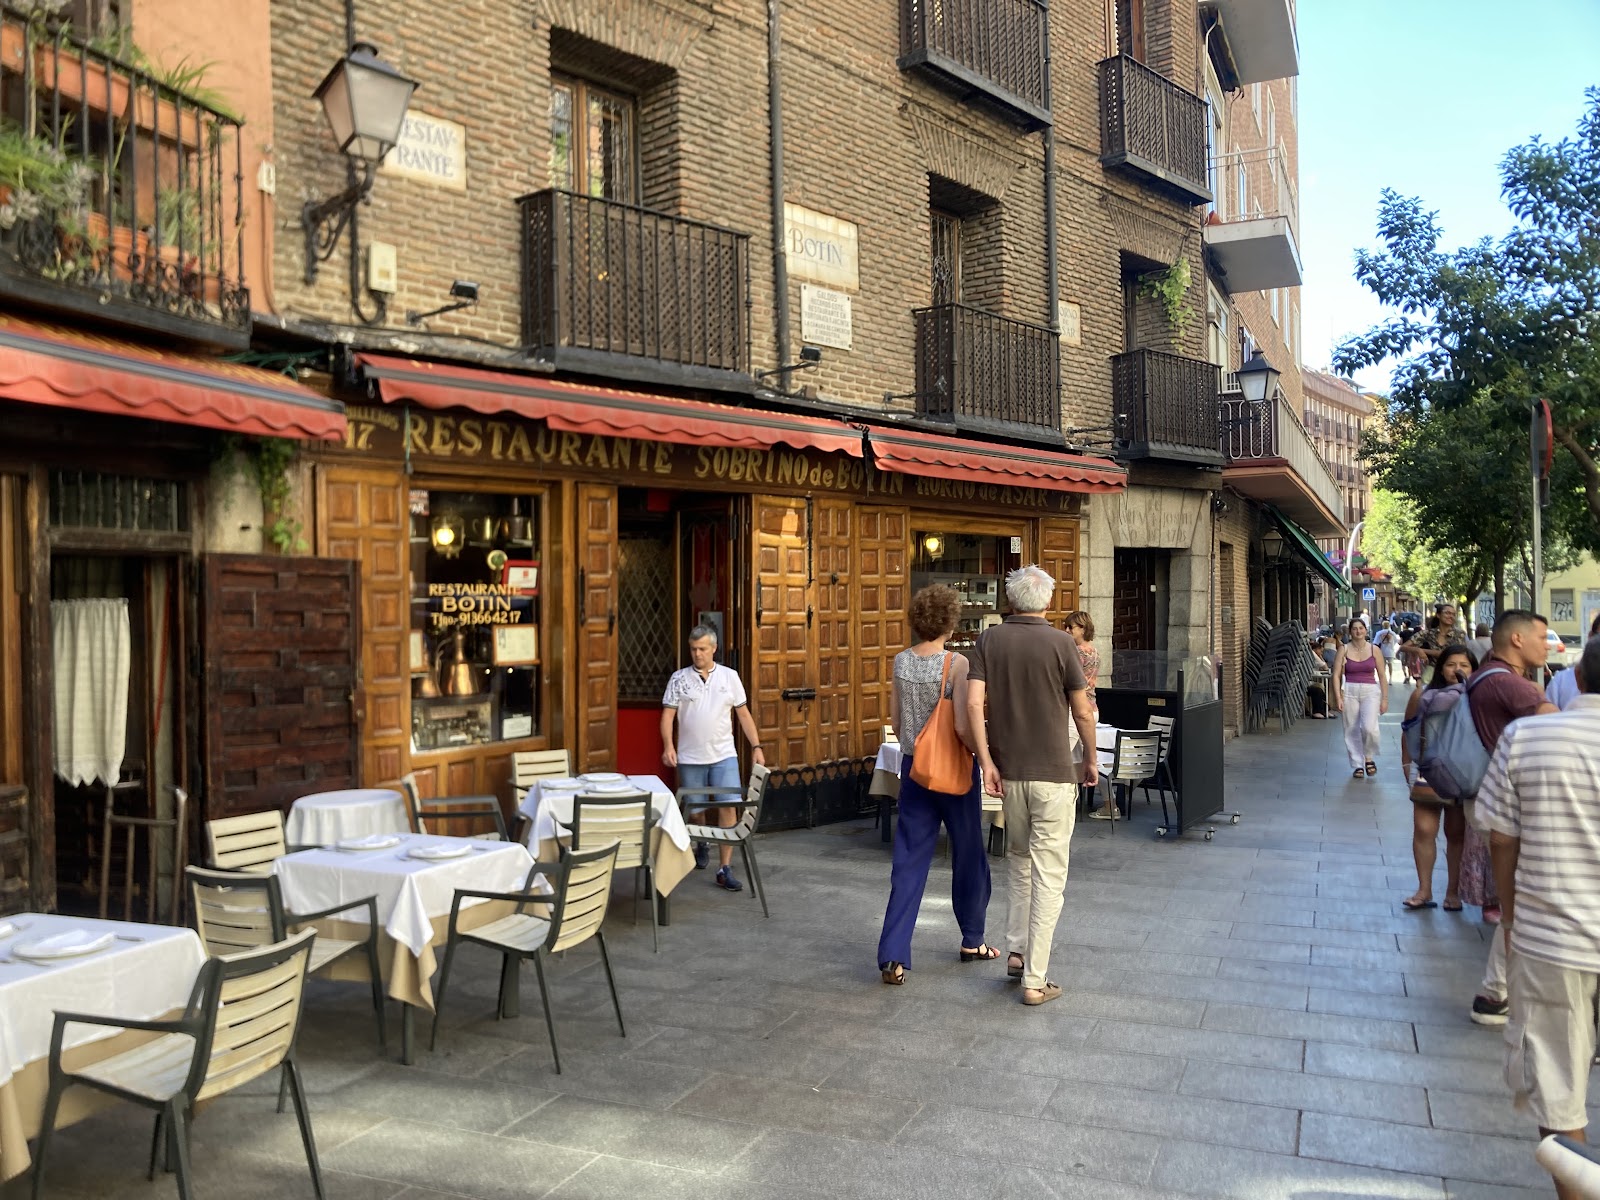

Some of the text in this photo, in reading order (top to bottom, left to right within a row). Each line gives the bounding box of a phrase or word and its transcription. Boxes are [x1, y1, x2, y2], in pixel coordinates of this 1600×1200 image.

[397, 143, 454, 178] RANTE
[788, 227, 843, 267] BOTÍN
[1061, 326, 1076, 338] SAR
[402, 413, 674, 474] RESTAURANTE
[694, 446, 809, 486] SOBRINO
[809, 460, 834, 487] de
[428, 583, 522, 597] RESTAURANTE
[442, 595, 511, 613] BOTIN
